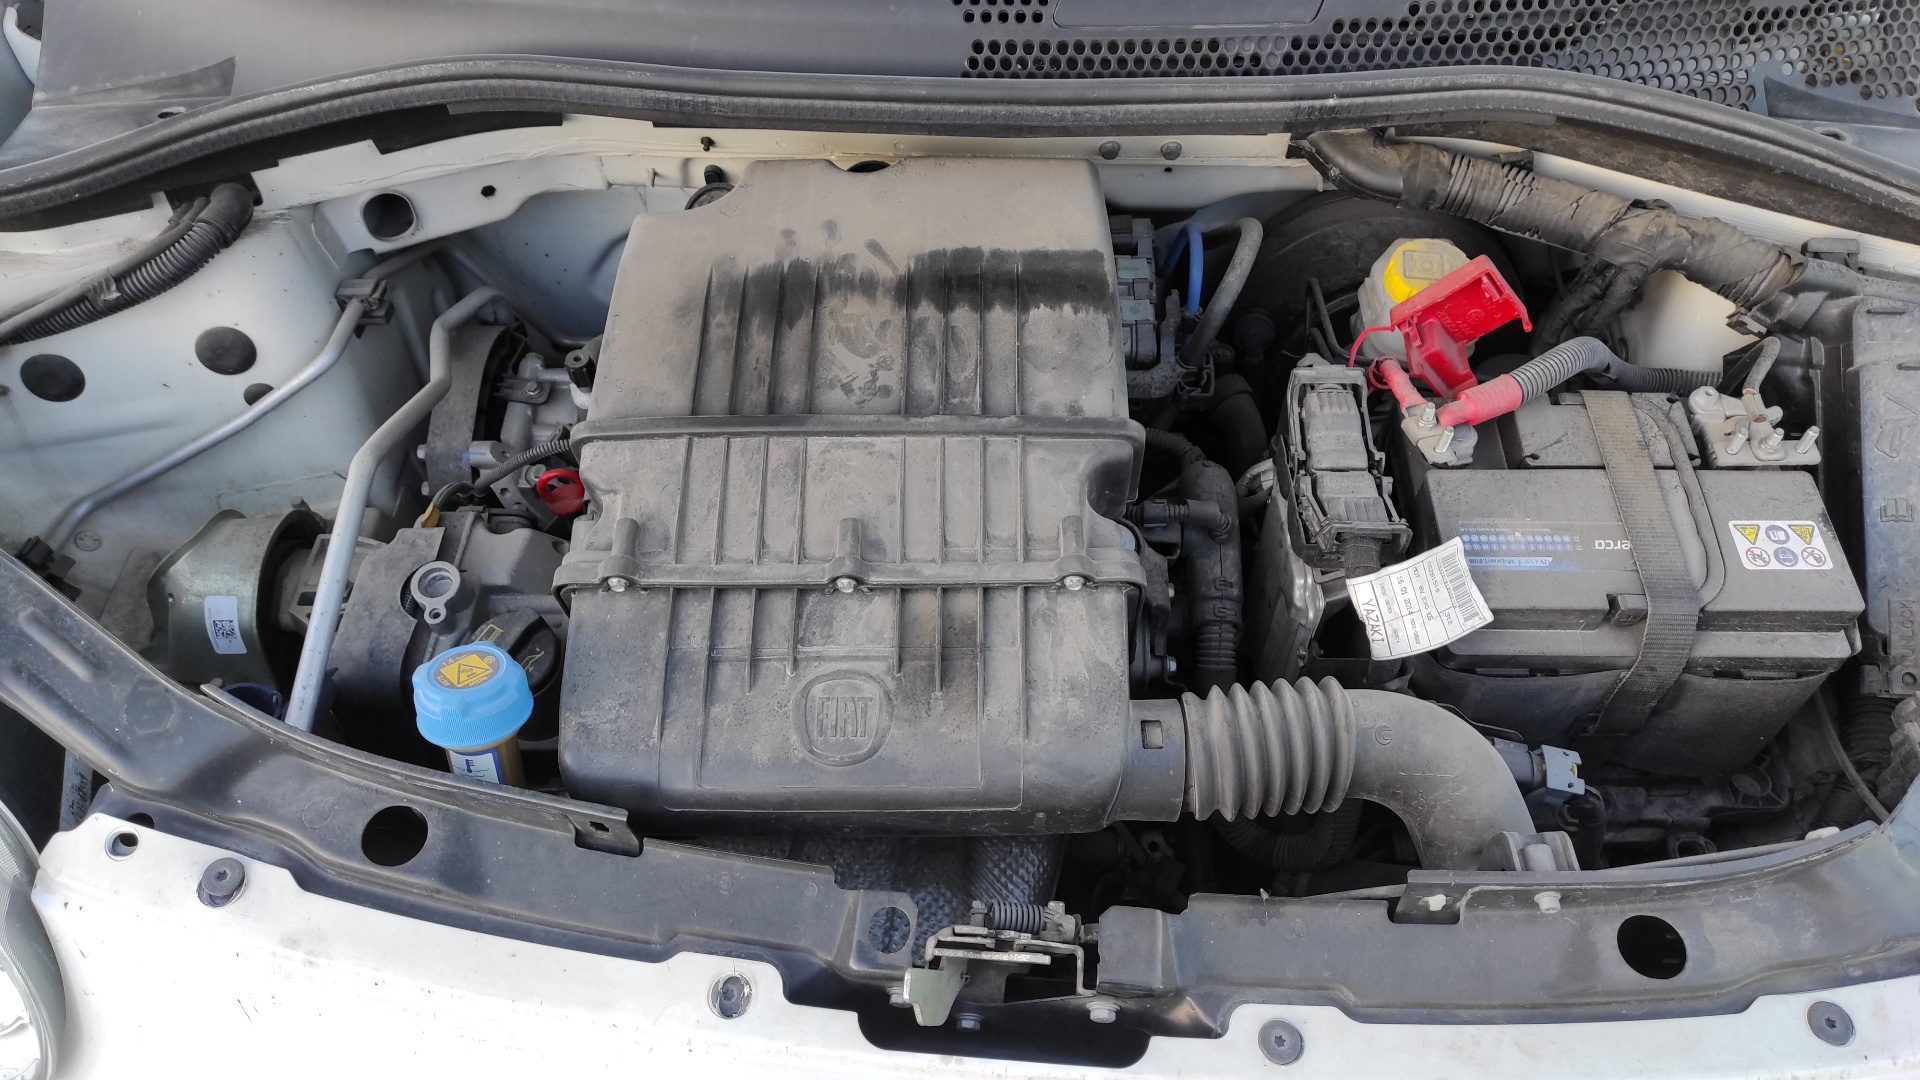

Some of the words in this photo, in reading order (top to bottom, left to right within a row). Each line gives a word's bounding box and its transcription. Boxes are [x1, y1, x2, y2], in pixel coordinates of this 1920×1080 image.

[1595, 540, 1630, 550] erca
[1362, 598, 1384, 643] YAZAKI
[1900, 602, 1914, 657] UNLOCK
[816, 696, 874, 738] FIAT
